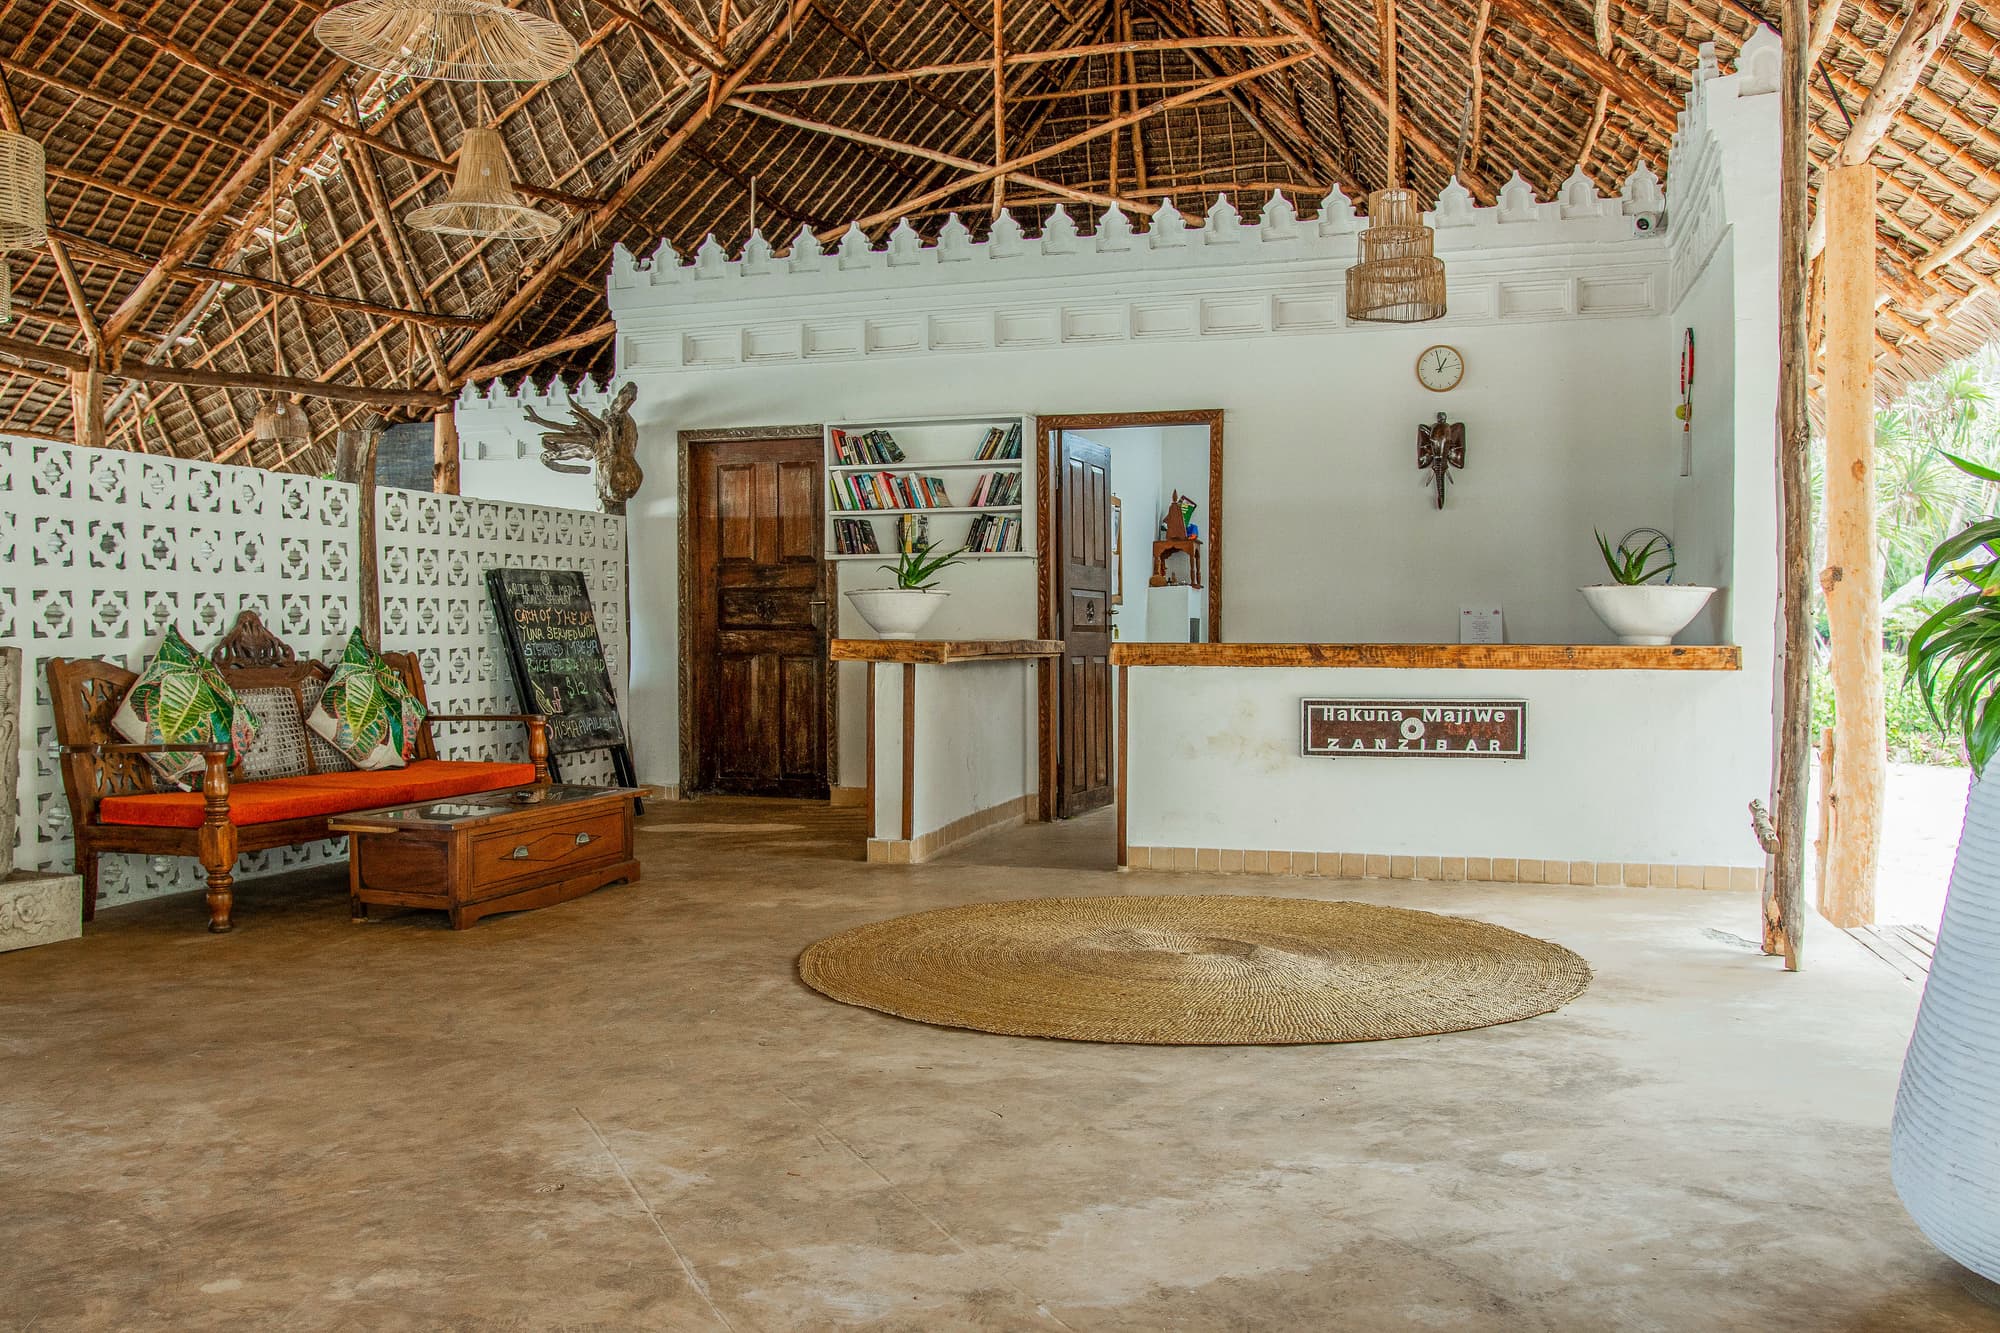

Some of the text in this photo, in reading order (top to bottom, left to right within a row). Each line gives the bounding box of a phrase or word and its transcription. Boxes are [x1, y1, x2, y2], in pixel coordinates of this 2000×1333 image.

[514, 608, 539, 624] CATCH
[540, 607, 552, 627] OF
[518, 624, 544, 641] TUNA
[547, 626, 577, 641] SERVED
[527, 658, 550, 673] RICE
[566, 676, 589, 699] $12
[1323, 707, 1403, 722] Hakuna
[1327, 738, 1501, 752] ZANZIBAR
